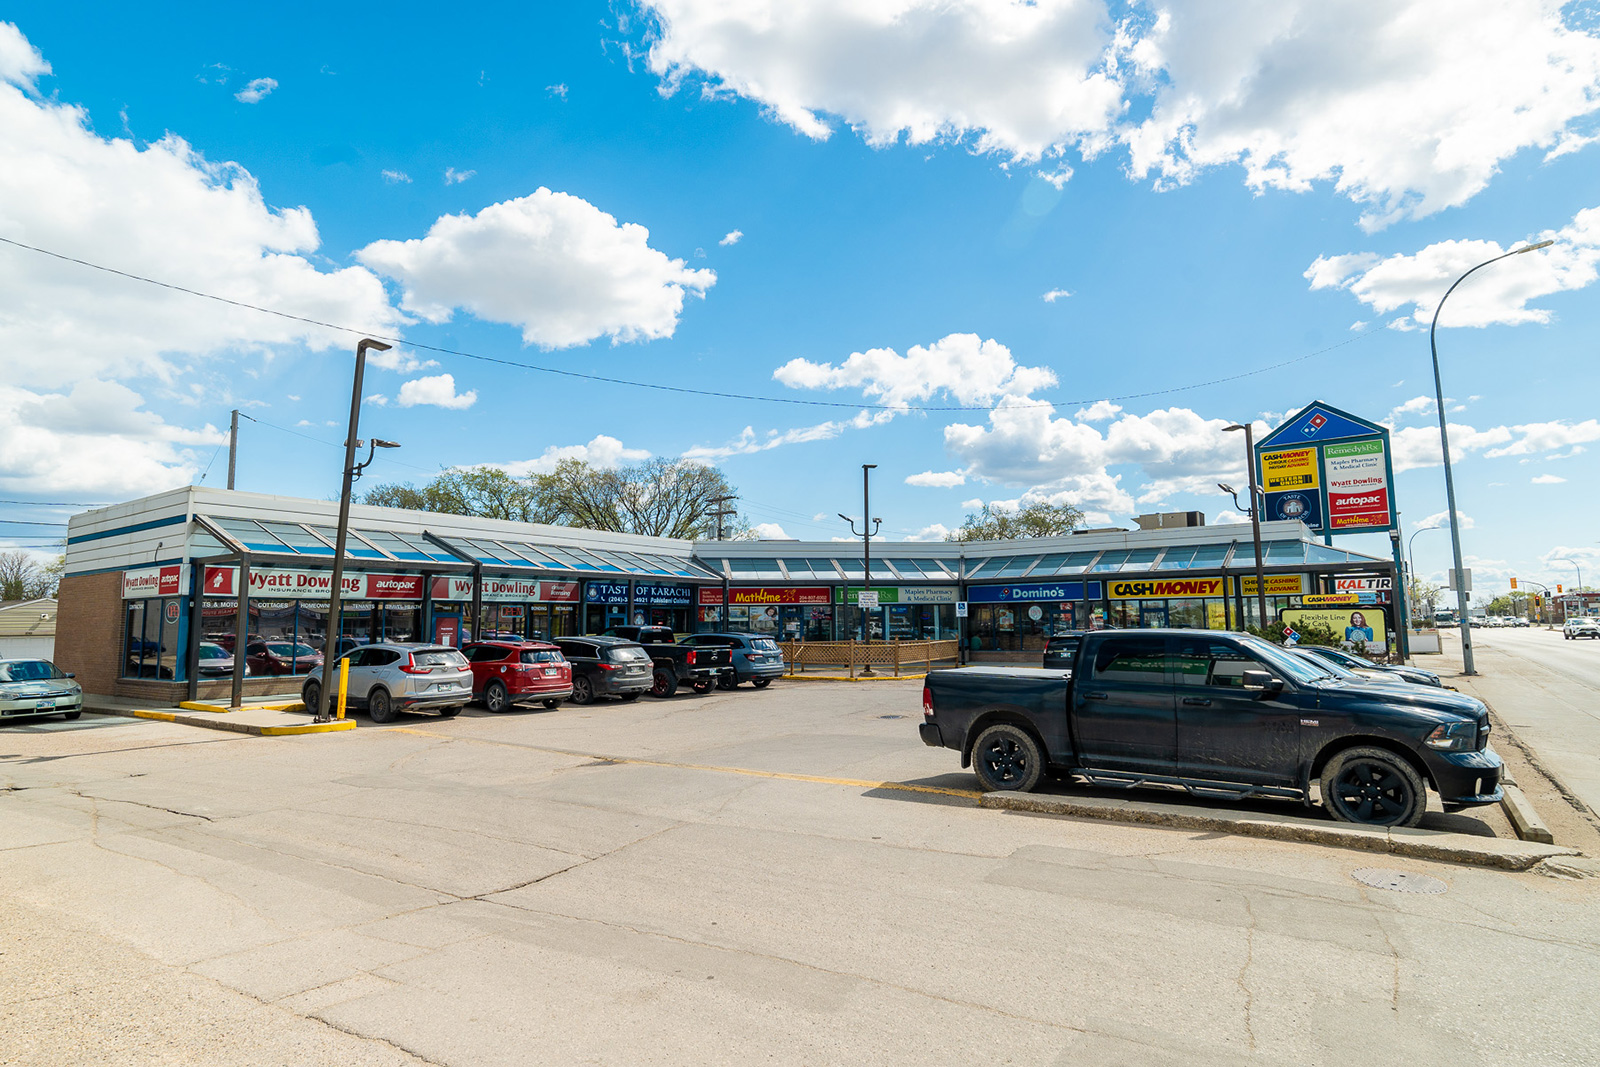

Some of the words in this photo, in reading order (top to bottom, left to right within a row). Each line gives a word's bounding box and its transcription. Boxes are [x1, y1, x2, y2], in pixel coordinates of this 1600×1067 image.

[1353, 477, 1383, 485] Dowling
[1336, 496, 1380, 505] autopac
[297, 574, 360, 592] Dowlng
[376, 580, 415, 590] autopac
[455, 580, 489, 594] Wytt
[492, 582, 536, 595] Dowling
[600, 585, 628, 594] TAST
[636, 586, 648, 595] OF
[651, 588, 690, 596] KARACHI
[735, 588, 781, 603] Math4me
[1012, 587, 1065, 598] Domino's
[502, 606, 522, 616] OPEN
